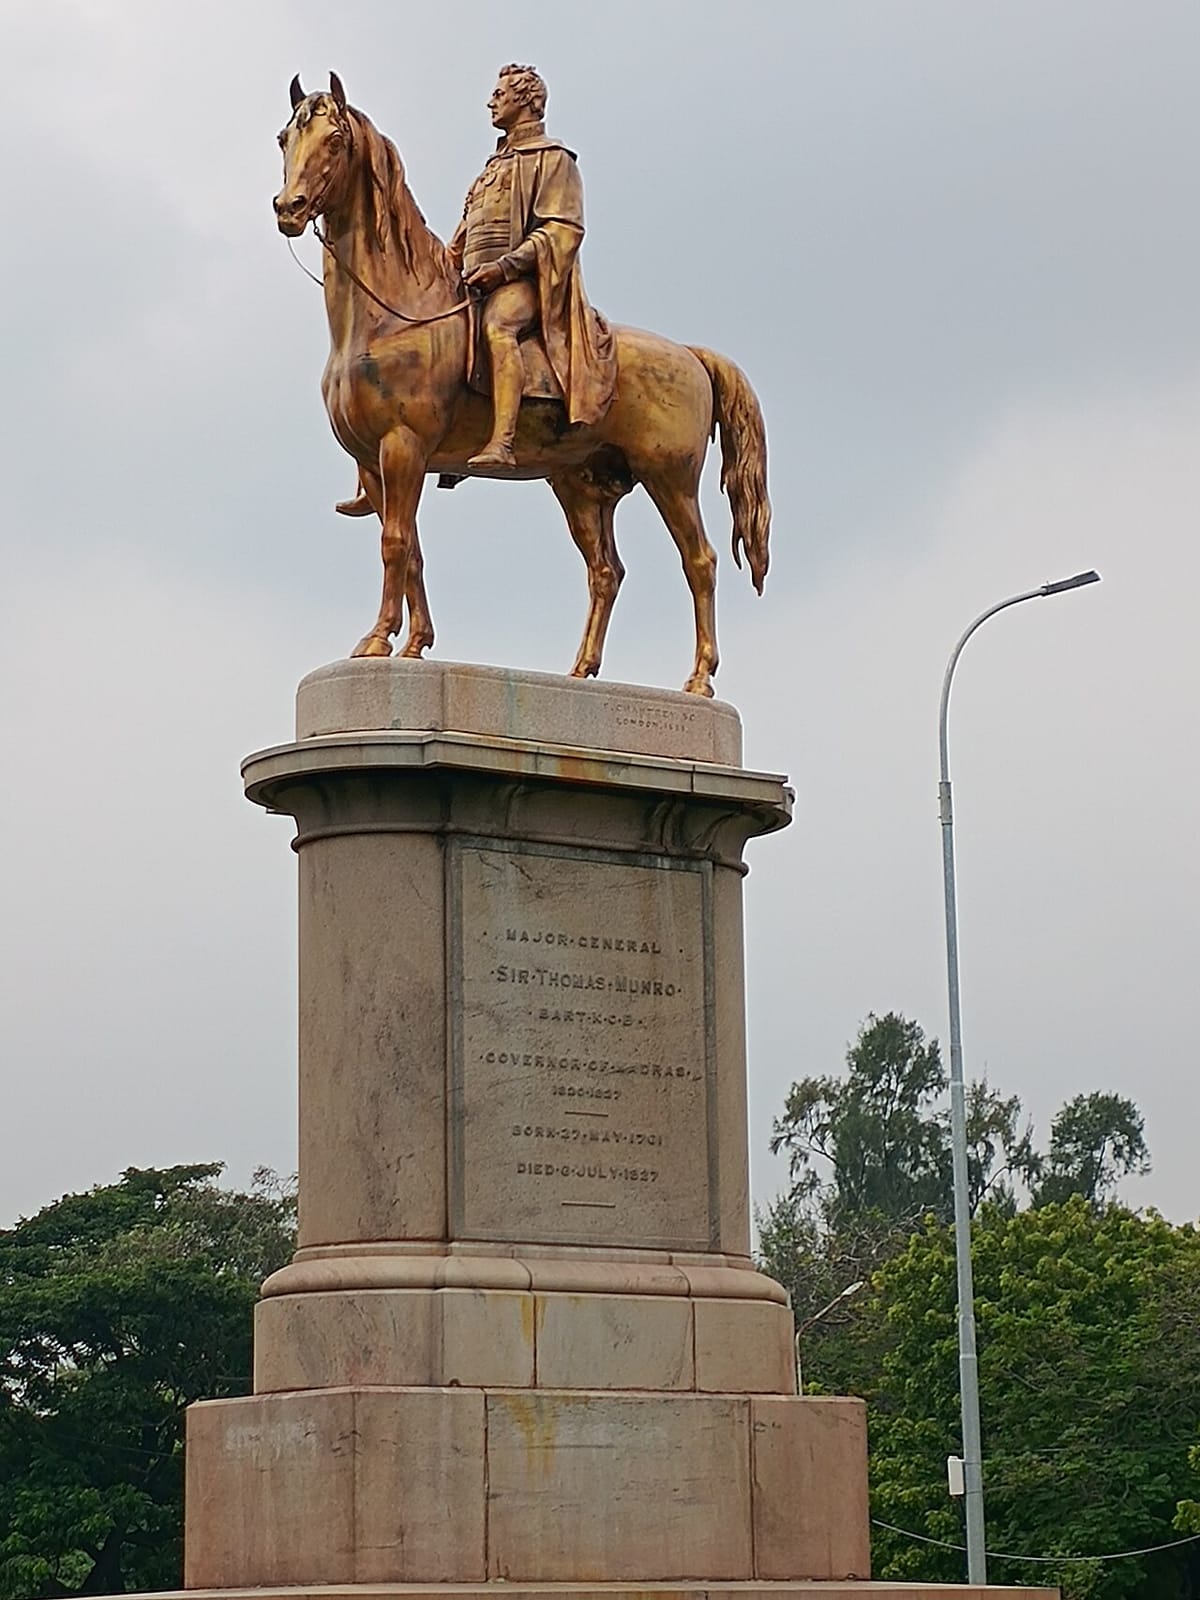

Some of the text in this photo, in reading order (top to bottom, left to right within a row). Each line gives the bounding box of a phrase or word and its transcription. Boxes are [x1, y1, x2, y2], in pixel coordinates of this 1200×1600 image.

[506, 929, 661, 954] MAJOR GENERAL
[497, 965, 676, 997] SIR THOMAS MUNRO
[517, 1163, 554, 1175] DIED
[575, 1165, 618, 1179] JULY
[623, 1168, 659, 1182] 1827
